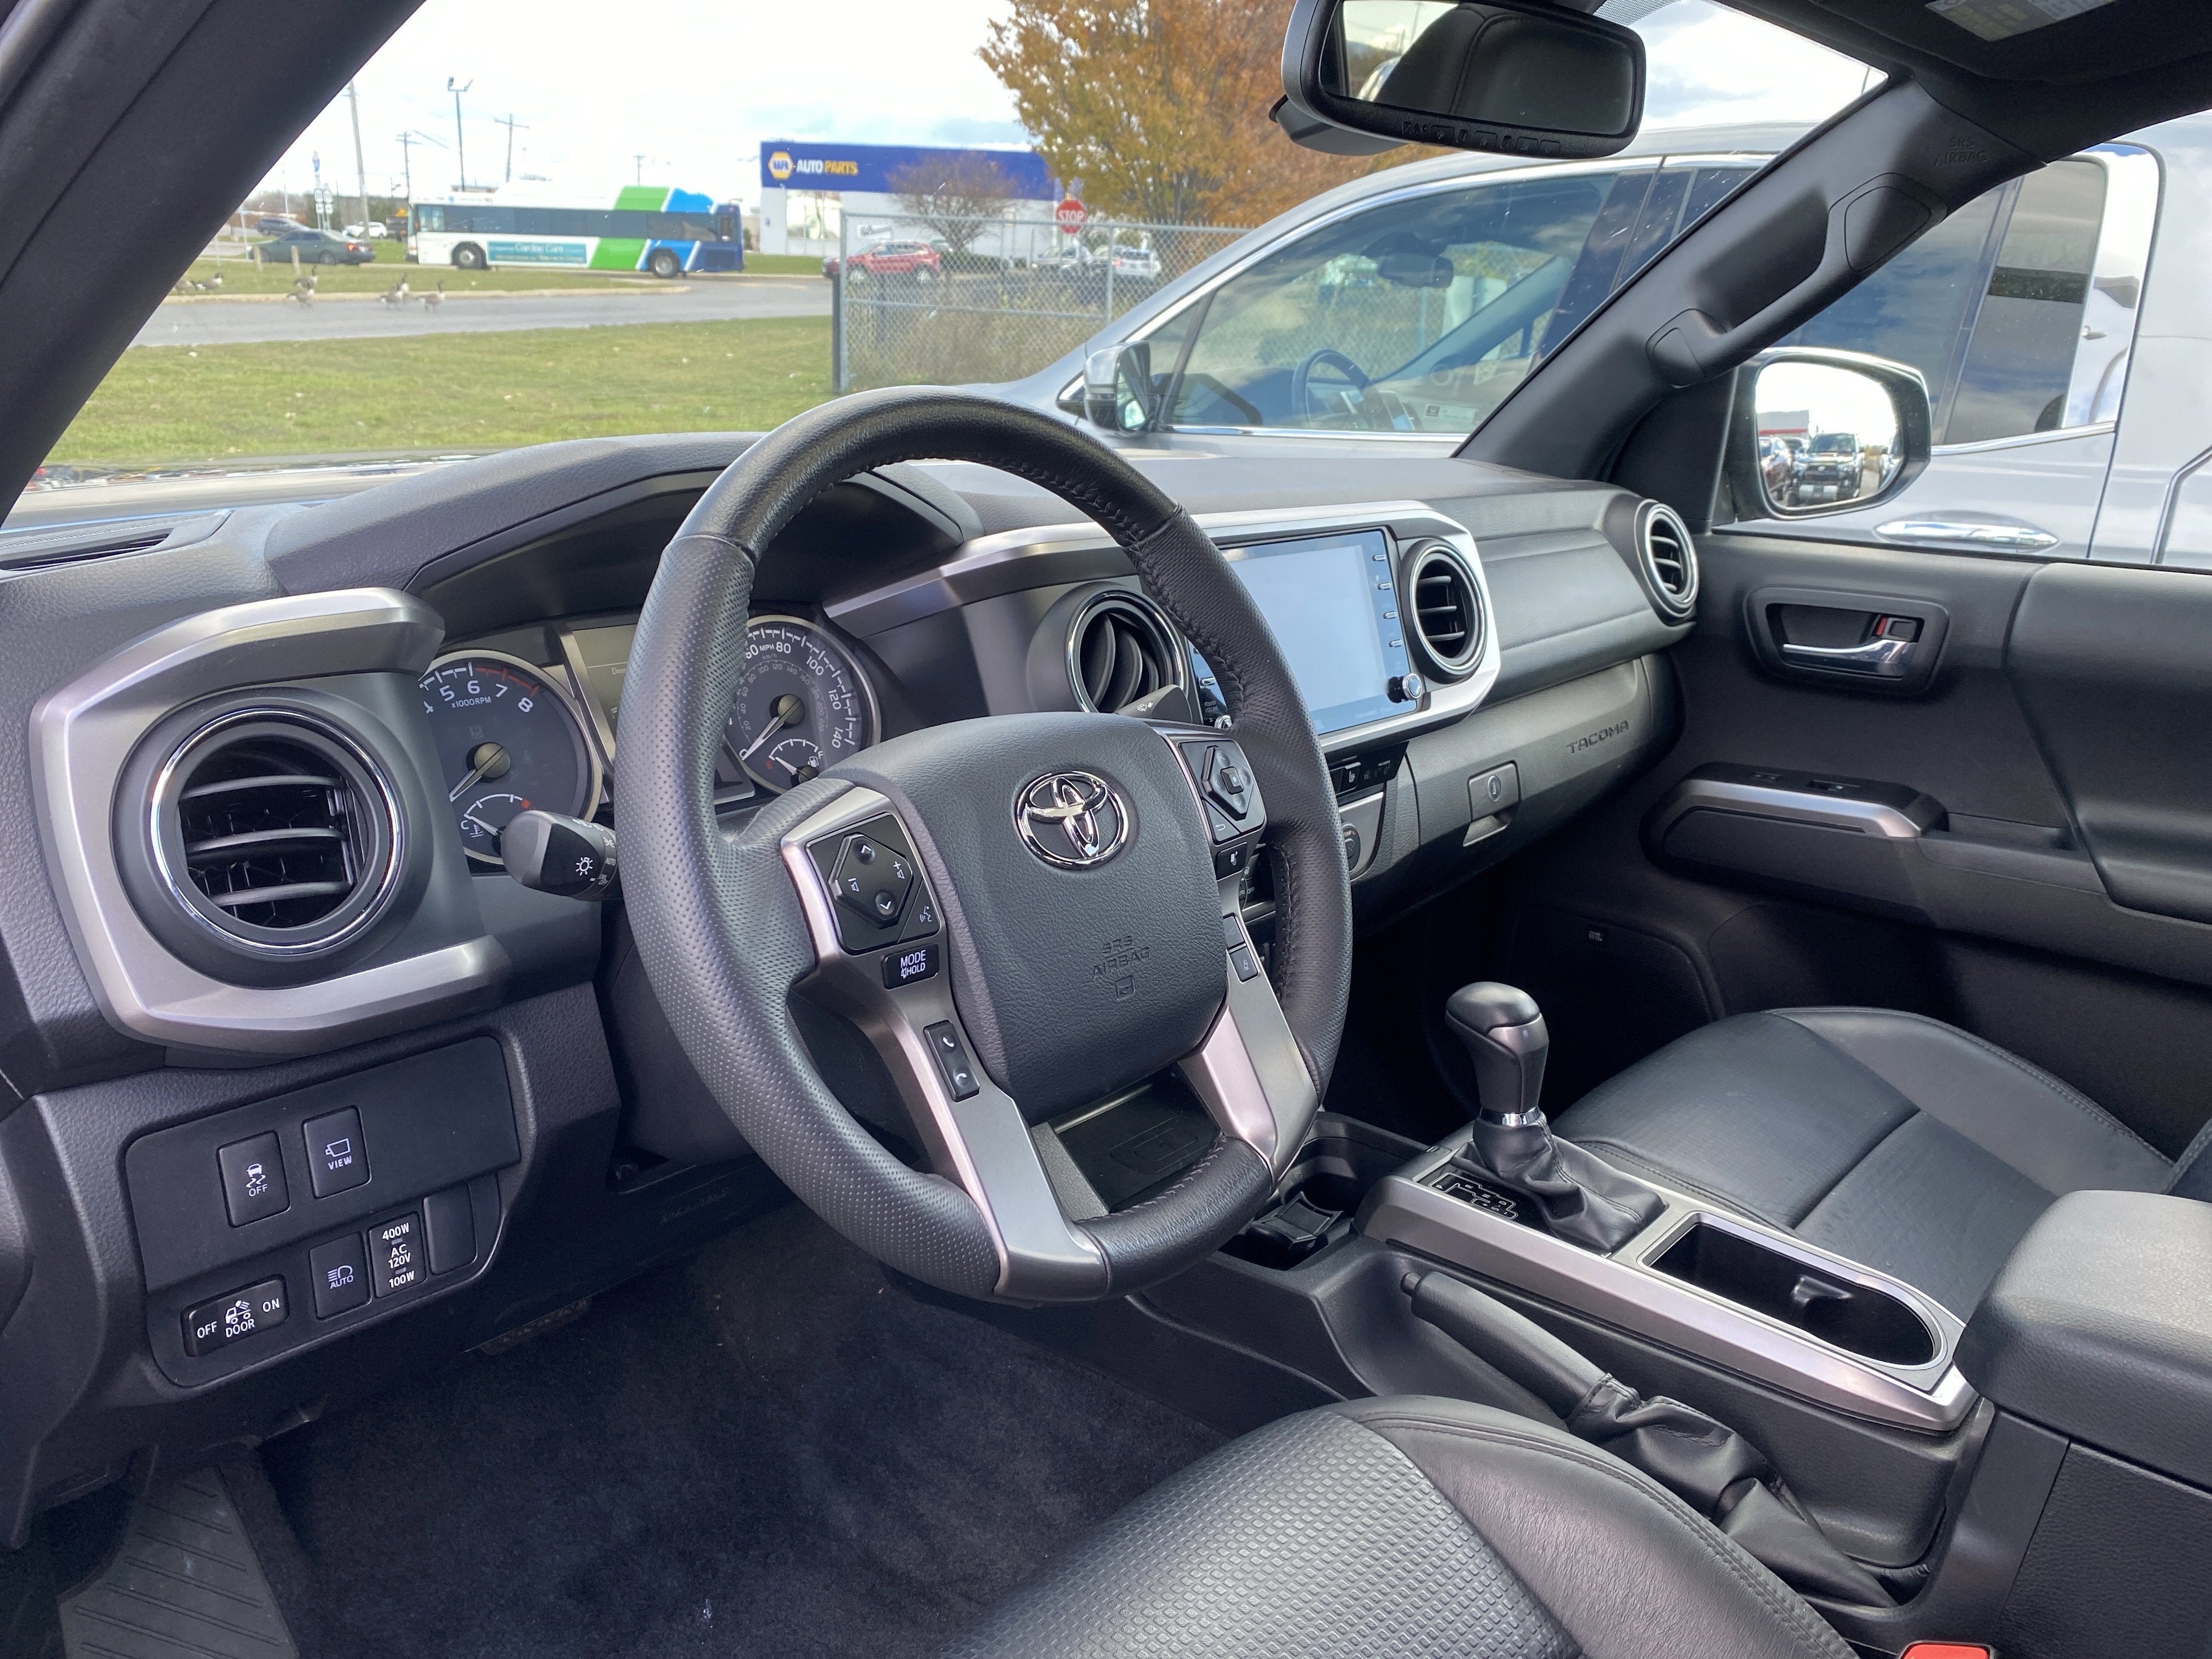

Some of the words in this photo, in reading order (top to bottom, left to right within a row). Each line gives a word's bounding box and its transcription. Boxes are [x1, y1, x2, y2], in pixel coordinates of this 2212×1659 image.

[796, 159, 823, 174] AUTO
[824, 160, 858, 176] PARTS
[1058, 210, 1085, 222] STOP
[759, 644, 775, 652] MPH
[776, 641, 791, 654] 80
[758, 664, 769, 674] 100
[787, 665, 798, 675] 140
[806, 656, 824, 676] 100
[747, 674, 757, 684] 80
[800, 674, 810, 685] 160
[439, 685, 455, 702] 5
[467, 680, 481, 694] 6
[495, 683, 508, 698] 7
[741, 686, 749, 697] 60
[518, 697, 533, 713] 8
[828, 689, 842, 710] 120
[741, 703, 747, 714] 40
[743, 720, 752, 731] 20
[832, 727, 843, 748] 140
[1567, 720, 1629, 753] TACOMA
[818, 750, 823, 759] F
[460, 820, 469, 830] C
[605, 857, 616, 866] AUTO
[1102, 935, 1132, 953] SRS
[900, 950, 926, 968] MODE
[1093, 947, 1151, 975] AIRBAG
[907, 962, 926, 976] HOLD
[328, 1155, 352, 1170] VIEW
[249, 1183, 268, 1197] OFF
[382, 1222, 409, 1240] 400W
[391, 1244, 408, 1258] AC
[388, 1252, 411, 1269] 120V
[330, 1275, 354, 1289] AUTO
[389, 1271, 414, 1288] 100W
[197, 1321, 217, 1339] OFF
[225, 1318, 255, 1338] DOOR
[262, 1298, 280, 1312] ON
